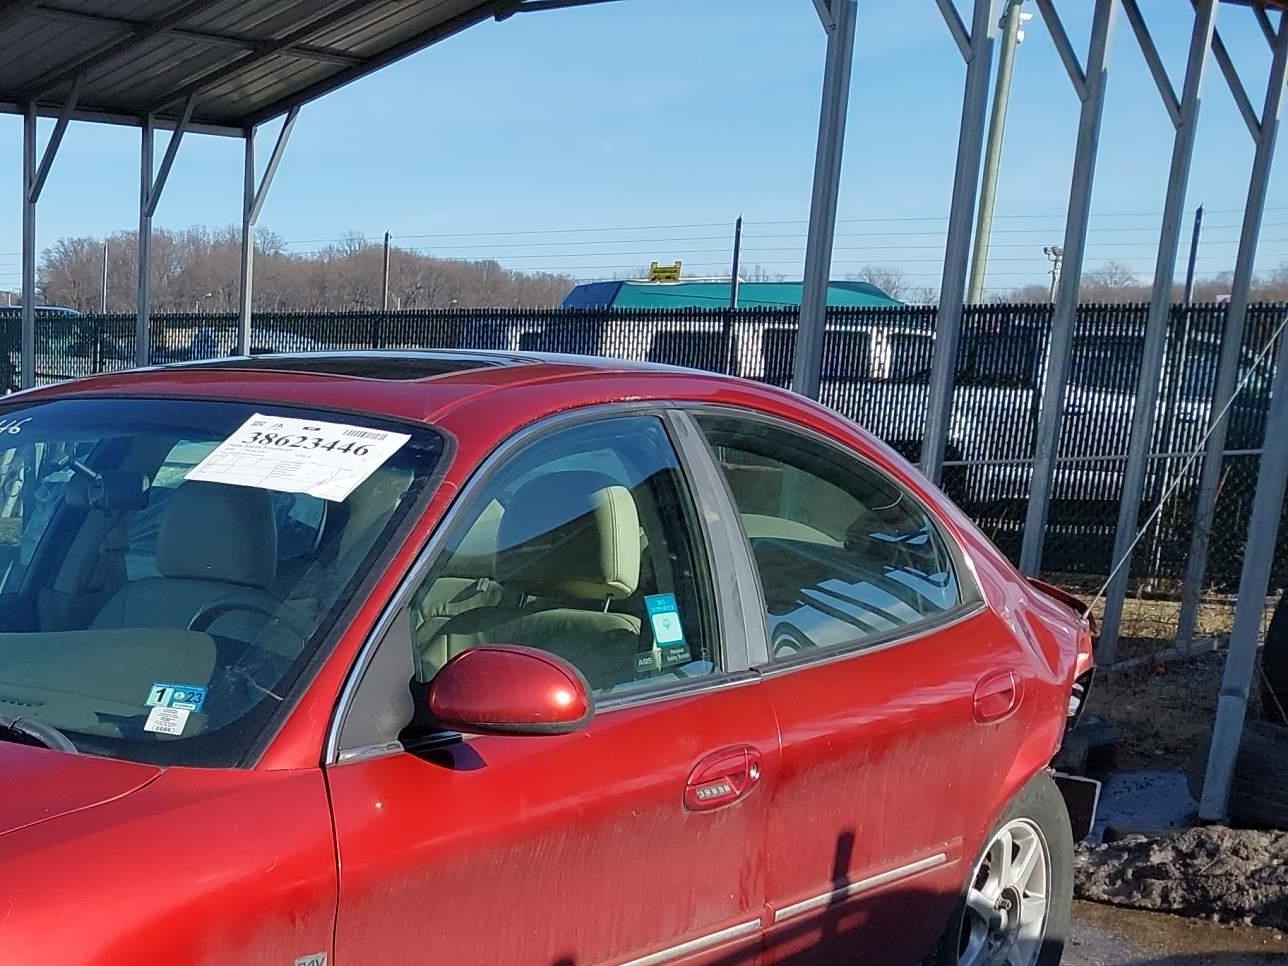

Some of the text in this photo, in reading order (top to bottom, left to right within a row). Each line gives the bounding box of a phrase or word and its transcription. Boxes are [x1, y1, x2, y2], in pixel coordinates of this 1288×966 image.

[242, 431, 376, 457] 38623446
[156, 688, 202, 703] 1 23
